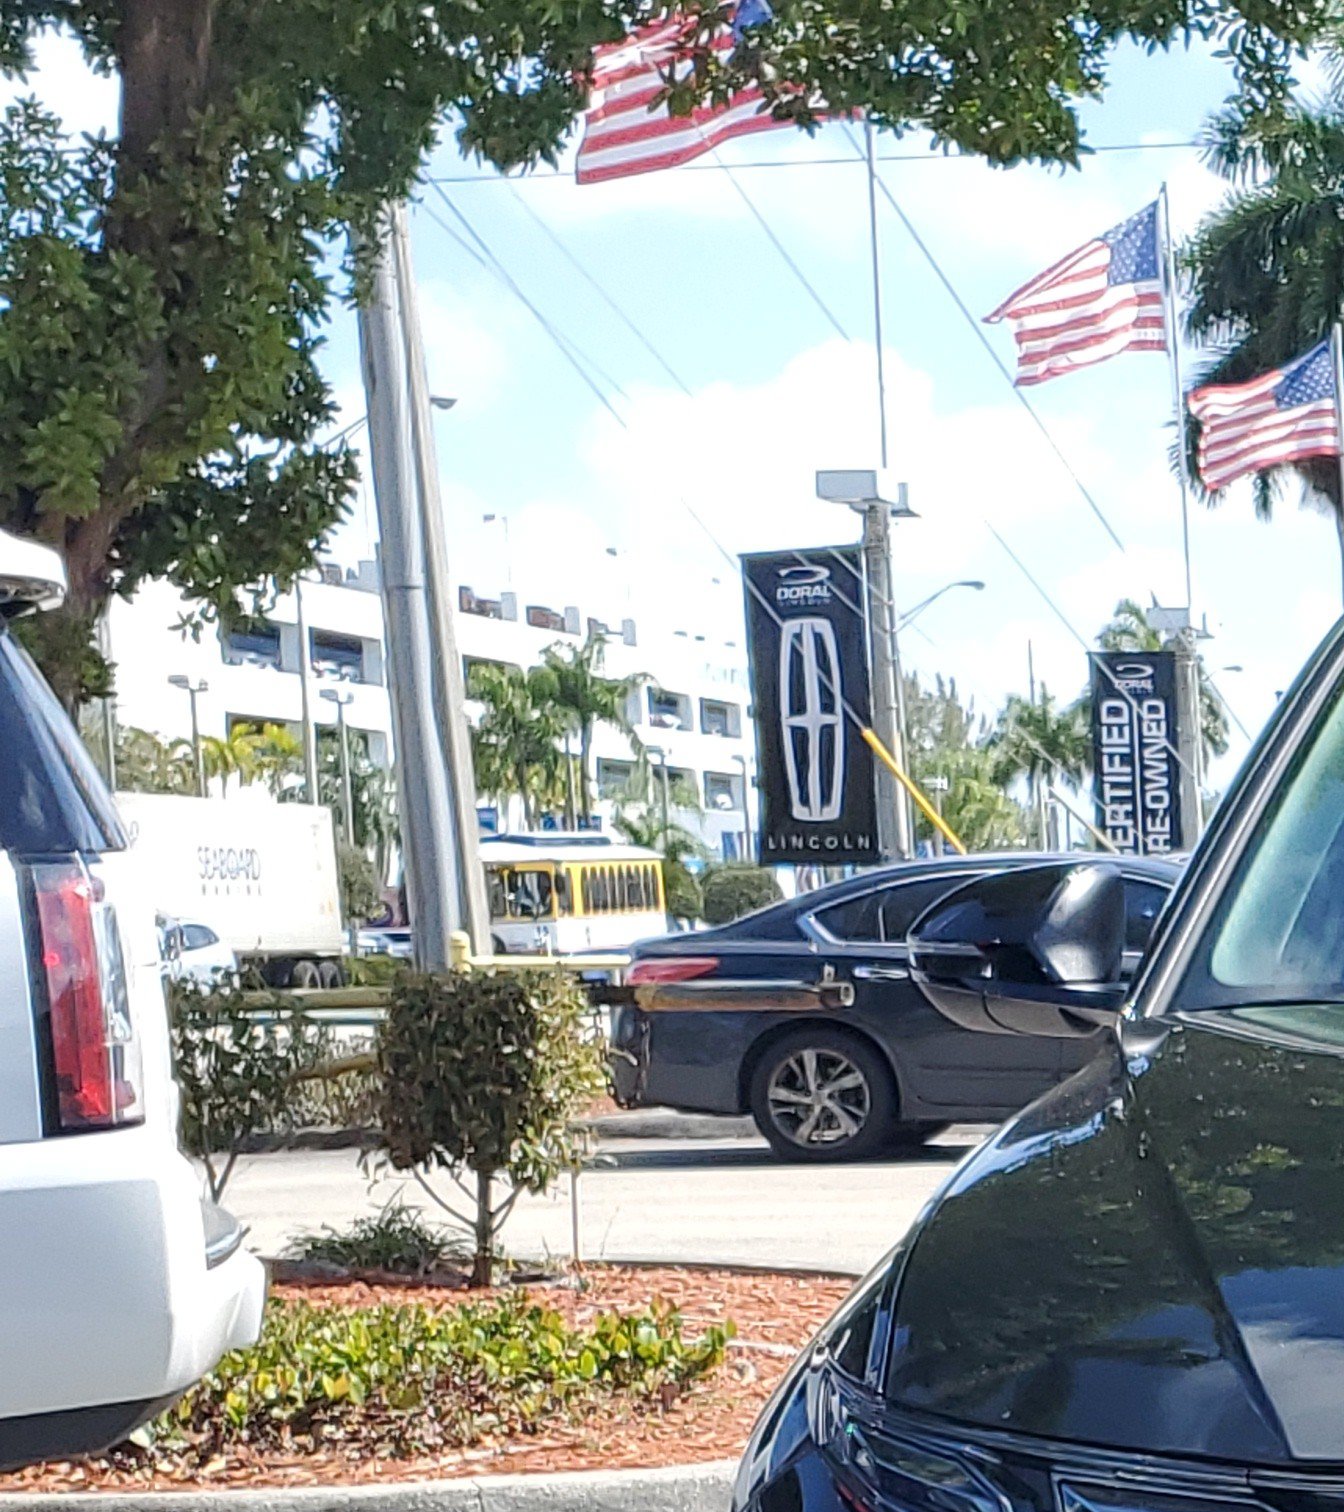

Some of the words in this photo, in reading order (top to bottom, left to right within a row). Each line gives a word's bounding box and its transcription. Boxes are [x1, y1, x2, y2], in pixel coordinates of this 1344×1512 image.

[776, 585, 832, 600] DORAL
[1142, 699, 1171, 855] RE-OWNED
[768, 833, 870, 850] LINCOLN
